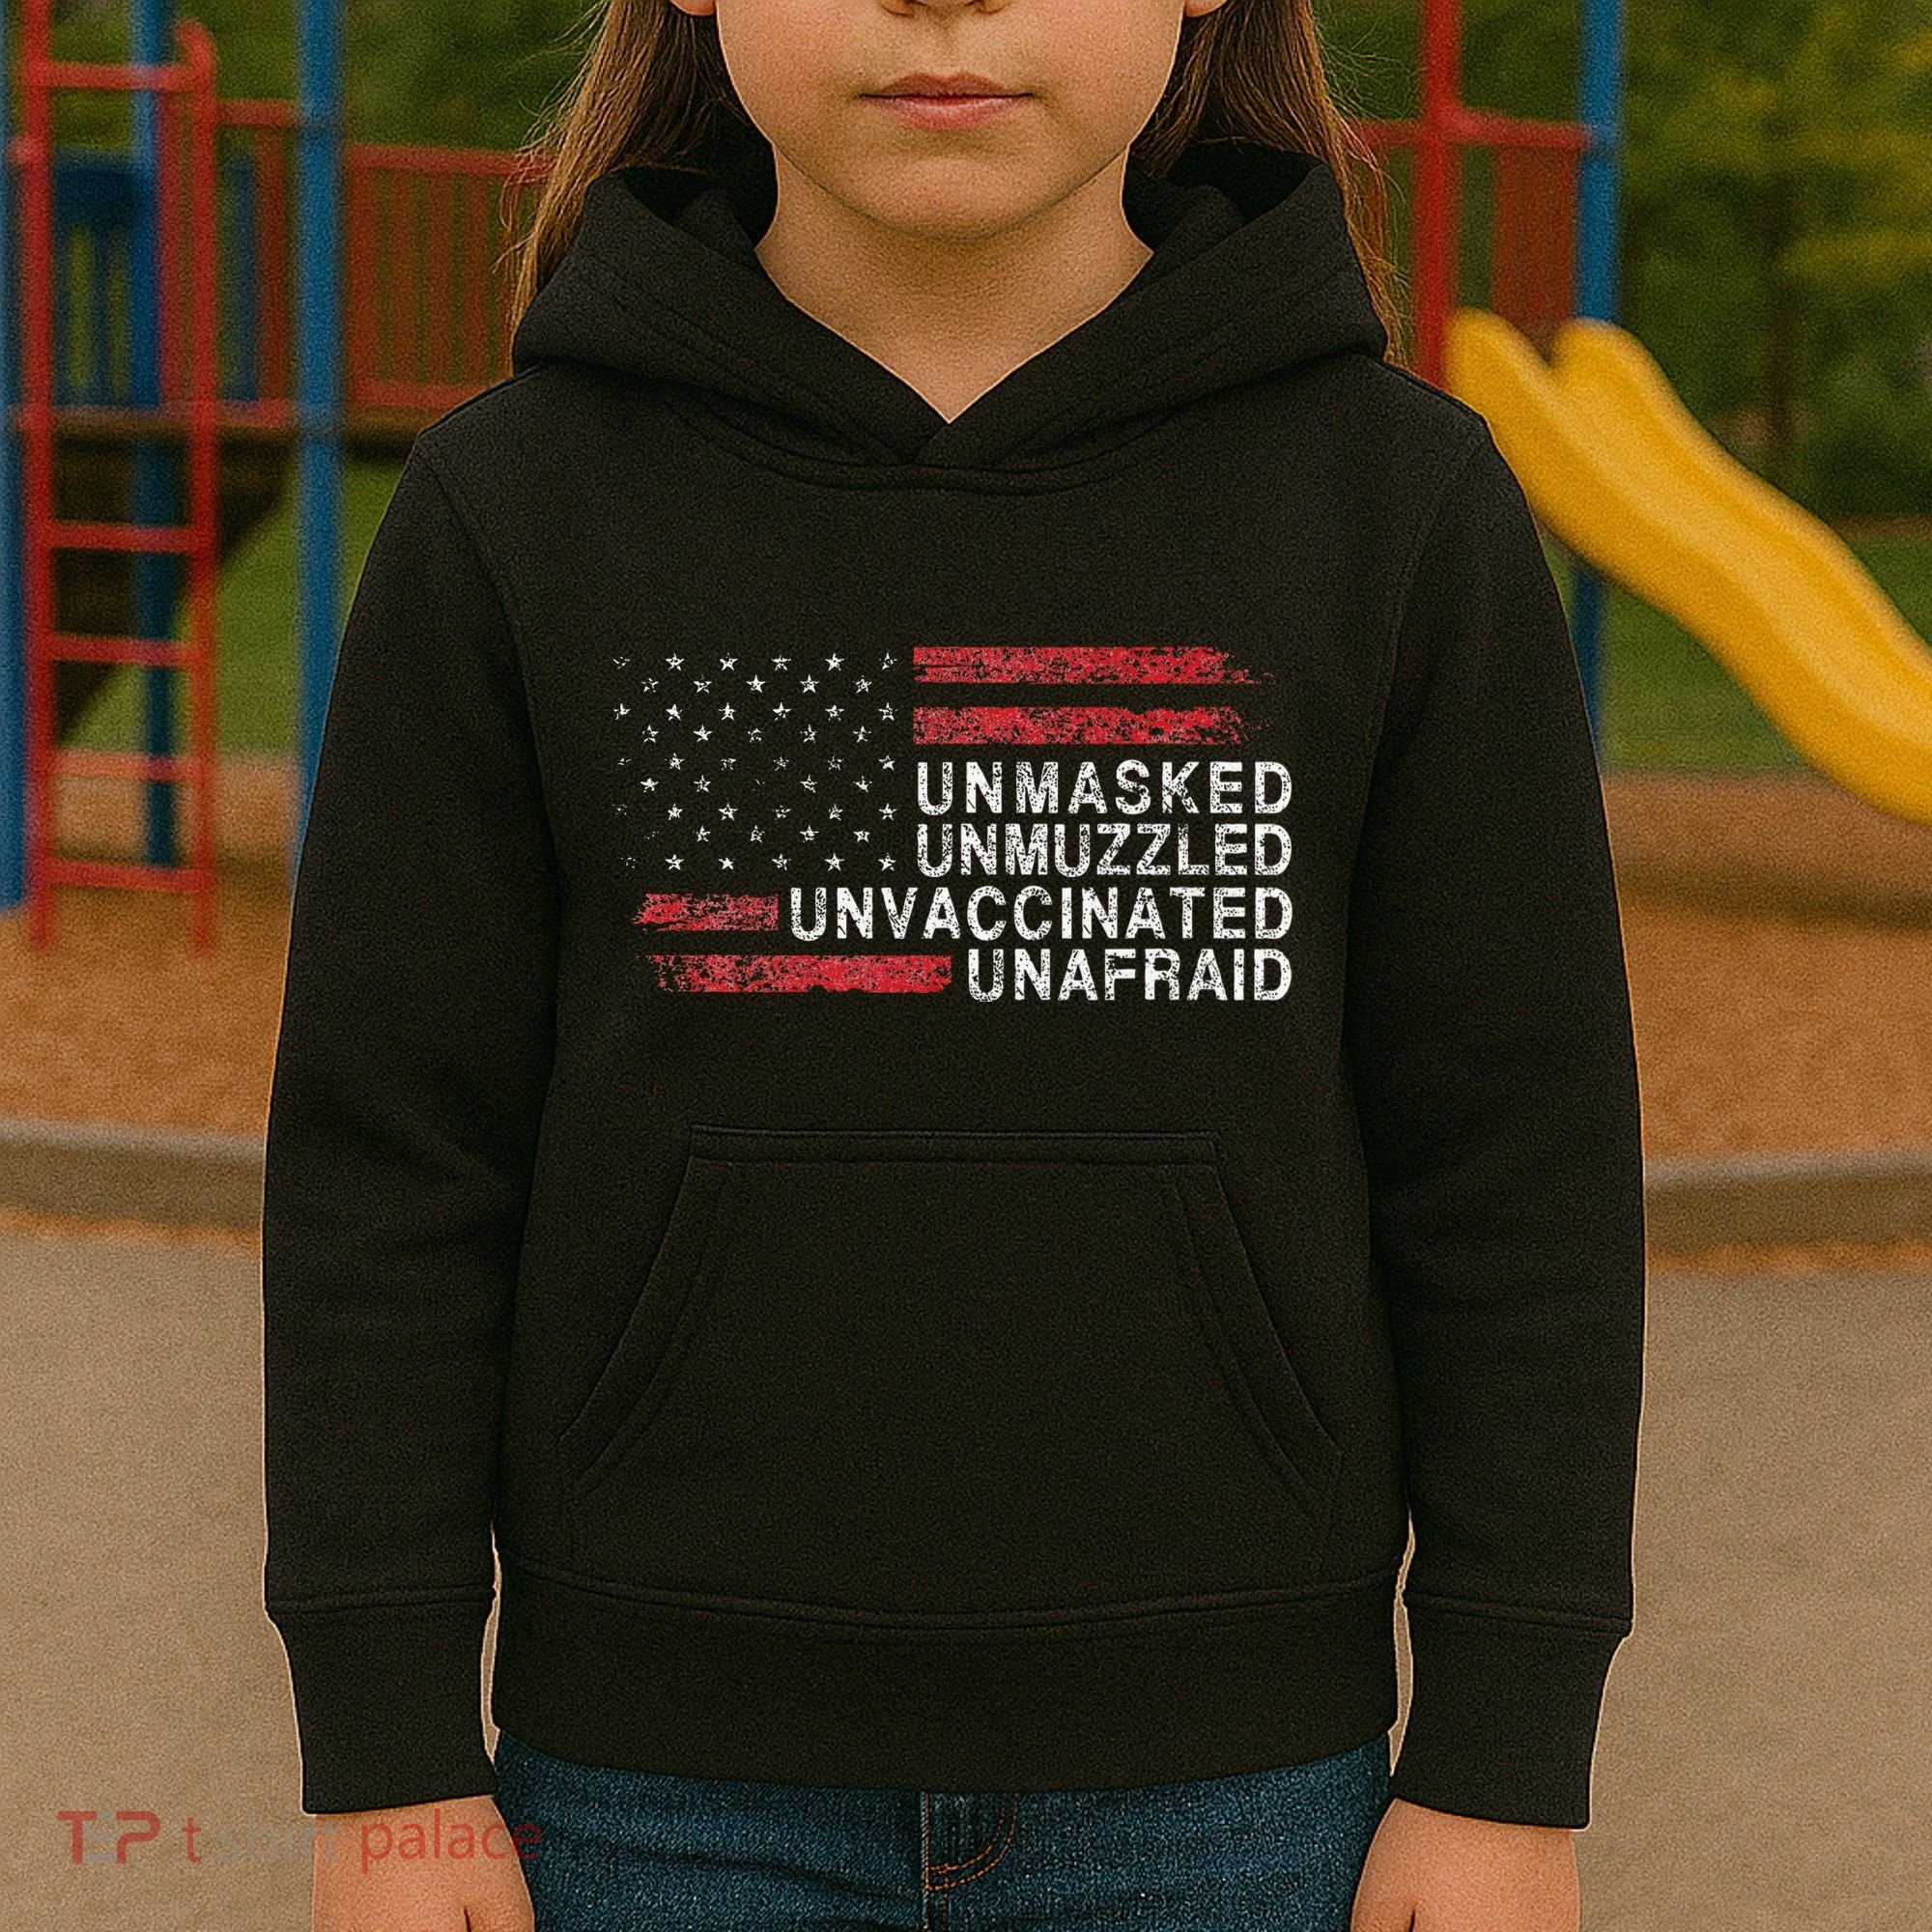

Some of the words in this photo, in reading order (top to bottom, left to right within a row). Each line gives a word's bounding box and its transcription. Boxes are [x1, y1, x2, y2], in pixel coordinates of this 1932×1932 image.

[917, 760, 1293, 815] UNMASKED
[917, 823, 1293, 877] UNMUZZLED
[789, 886, 1293, 941] UNVACCINATED
[967, 949, 1293, 1002] UNAFRAID
